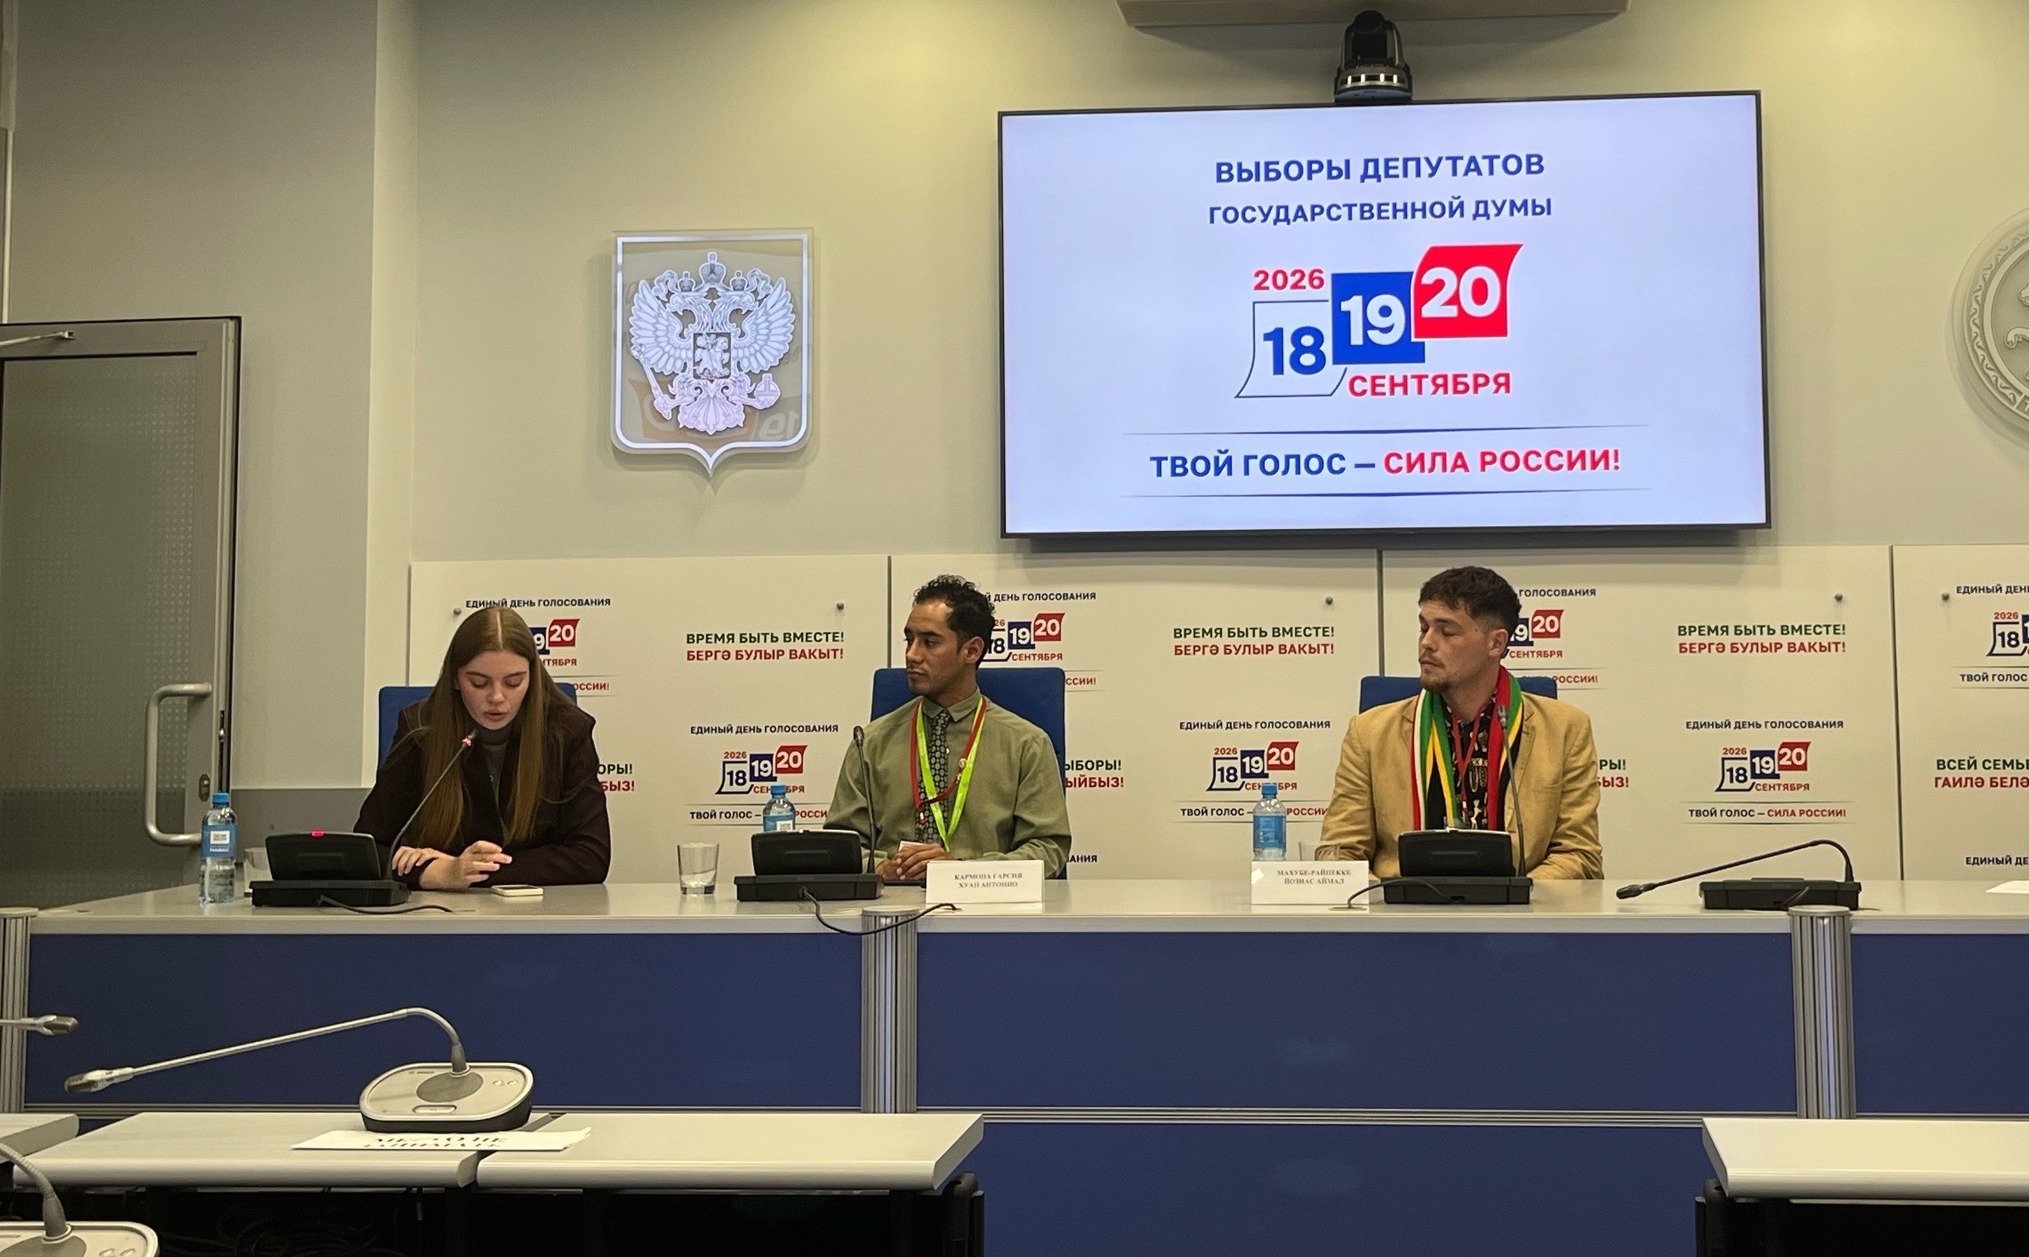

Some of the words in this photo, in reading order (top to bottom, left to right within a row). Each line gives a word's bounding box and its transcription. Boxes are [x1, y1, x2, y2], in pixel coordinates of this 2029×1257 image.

[1216, 159, 1351, 183] ВЫБОРЫ
[1360, 153, 1545, 183] ДЕПУТАТОВ
[1209, 195, 1465, 225] ГОСУДАРСТВЕННОЙ
[1472, 198, 1552, 221] ДУМЫ
[1253, 268, 1325, 291] 2026
[1263, 326, 1326, 375] 18
[1340, 294, 1406, 345] 19
[1420, 266, 1501, 318] 20
[1348, 372, 1511, 397] СЕНТЯБРЯ
[1150, 449, 1233, 477] ТВОЙ
[1243, 452, 1346, 476] ГОЛОС
[1383, 450, 1470, 475] СИЛА
[1480, 448, 1620, 472] РОССИИ!
[1519, 588, 1596, 597] ГОЛОСОВАНИЯ
[1956, 584, 2002, 594] ЕДИНЫЙ
[2005, 585, 2029, 594] ДЕН
[466, 599, 507, 608] ЕДИНЫЙ
[510, 599, 535, 608] ДЕНЬ
[538, 598, 611, 606] ГОЛОСОВАНИЯ
[993, 593, 1020, 602] ДЕНЬ
[1022, 592, 1096, 601] ГОЛОСОВАНИЯ
[1994, 611, 2019, 620] 2026
[994, 619, 1006, 627] 26
[1511, 624, 1529, 642] 9
[1532, 615, 1559, 633] 20
[549, 624, 575, 642] 20
[1009, 627, 1031, 645] 19
[1034, 619, 1060, 636] 20
[1173, 627, 1223, 639] ВРЕМЯ
[1227, 627, 1268, 638] БЫТЬ
[1271, 626, 1334, 637] ВМЕСТЕ!
[1677, 625, 1729, 637] ВРЕМЯ
[1733, 624, 1776, 636] БЫТЬ
[1780, 624, 1846, 636] ВМЕСТЕ!
[686, 633, 735, 644] ВРЕМЯ
[739, 632, 779, 644] БЫТЬ
[783, 631, 844, 643] ВМЕСТЕ!
[1997, 631, 2020, 648] 18
[1174, 644, 1219, 656] БЕРГӘ
[1223, 644, 1274, 655] БУЛЫР
[1278, 643, 1334, 655] ВАКЫТ!
[1678, 642, 1726, 654] БЕРГӘ
[1730, 641, 1783, 653] БУЛЫР
[1787, 641, 1846, 653] ВАКЫТ!
[686, 650, 731, 661] БЕРГӘ
[735, 649, 785, 661] БУЛЫР
[789, 648, 844, 660] ВАКЫТ!
[1012, 652, 1063, 662] СЕНТЯБРЯ
[1509, 650, 1563, 659] СЕНТЯБРЯ
[543, 658, 577, 667] ТЯБРЯ
[1065, 677, 1097, 686] ССИИ!
[1960, 672, 1989, 682] ТВОЙ
[1992, 673, 2028, 682] ГОЛОС
[574, 682, 610, 691] ОССИИ!
[690, 724, 733, 735] ЕДИНЫЙ
[735, 725, 762, 734] ДЕНЬ
[764, 724, 839, 733] ГОЛОСОВАНИЯ
[1179, 720, 1223, 730] ЕДИНЫЙ
[1225, 721, 1253, 730] ДЕНЬ
[1254, 720, 1330, 729] ГОЛОСОВАНИЯ
[1686, 719, 1731, 730] ЕДИНЫЙ
[1734, 721, 1762, 730] ДЕНЬ
[1764, 720, 1844, 729] ГОЛОСОВАНИЯ
[723, 751, 747, 759] 2026
[1214, 747, 1238, 756] 2026
[1722, 747, 1747, 756] 2026
[598, 763, 633, 775] ОРЫ!
[726, 770, 747, 787] 18
[751, 760, 772, 778] 19
[776, 750, 802, 769] 20
[1065, 759, 1122, 771] ЫБОРЫ!
[1217, 766, 1238, 783] 18
[1242, 756, 1264, 774] 19
[1267, 747, 1294, 765] 20
[1726, 766, 1748, 784] 18
[1751, 756, 1774, 774] 19
[1779, 747, 1806, 766] 20
[1936, 756, 1977, 770] ВСЕЙ
[1065, 774, 1124, 788] ЫЙБЫЗ!
[1244, 782, 1297, 791] СЕНБРЯ
[1755, 783, 1810, 791] СЕНТЯБРЯ
[1934, 776, 1985, 788] ГАИЛӘ
[1990, 776, 2029, 788] БЕЛӘ
[753, 785, 805, 794] СЕНБРЯ
[690, 809, 717, 820] ТВОЙ
[719, 810, 752, 819] ГОЛОС
[795, 810, 828, 819] РОССИ
[1181, 807, 1208, 817] ТВОЙ
[1211, 807, 1244, 816] ГОЛОС
[1287, 807, 1329, 816] РОССИИ
[1688, 808, 1717, 817] ТВОЙ
[1720, 808, 1755, 817] ГОЛОС
[1767, 808, 1796, 817] СИЛА
[1799, 808, 1846, 817] РОССИИ!
[1966, 854, 2012, 866] ЕДИНЫЙ
[2015, 856, 2029, 866] ДЕ
